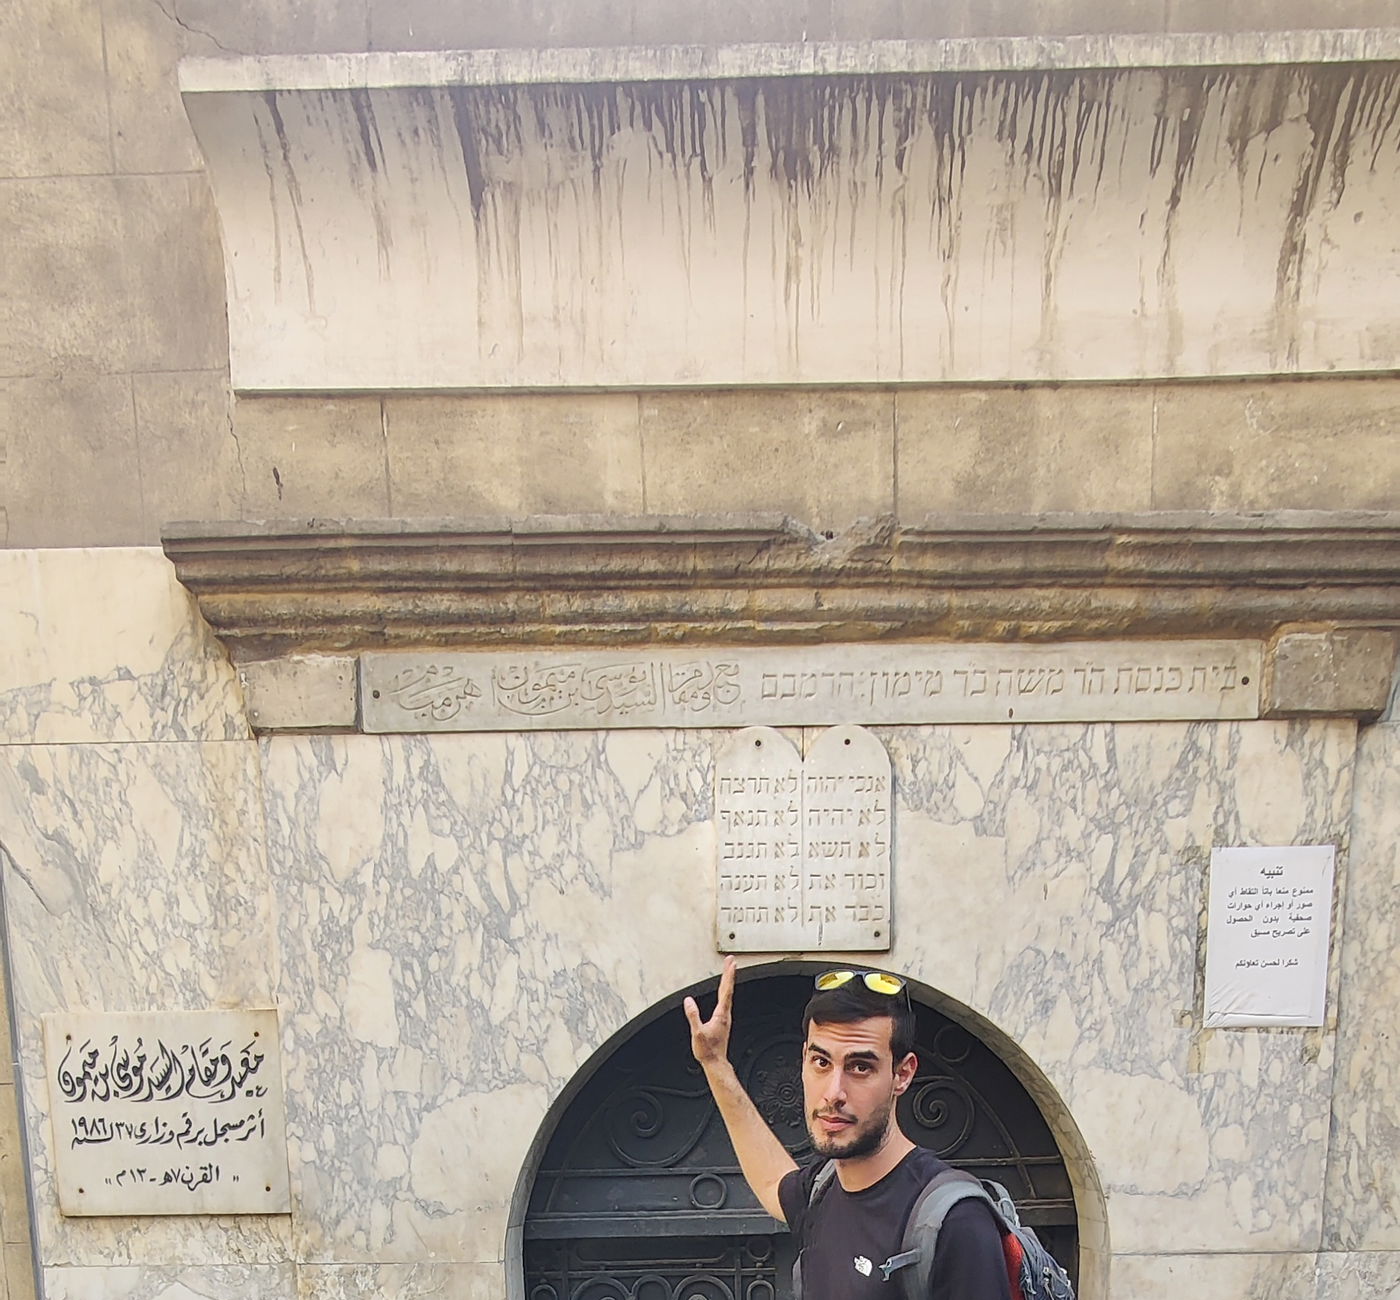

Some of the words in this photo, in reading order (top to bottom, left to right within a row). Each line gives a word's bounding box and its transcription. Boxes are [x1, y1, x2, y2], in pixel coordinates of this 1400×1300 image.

[995, 667, 1064, 697] משה
[1113, 665, 1183, 695] כנסת
[1187, 664, 1237, 694] בית
[719, 777, 770, 795] תרצח
[773, 768, 798, 794] לא
[806, 776, 844, 793] יהוה
[848, 775, 886, 793] אנכי
[720, 809, 768, 834] תנאף
[773, 800, 799, 827] לא
[808, 808, 853, 827] יהיה
[857, 799, 886, 826] לא
[773, 833, 800, 859] לא
[808, 841, 851, 858] תשא
[857, 832, 886, 858] לא
[773, 865, 800, 891] לא
[844, 873, 886, 890] זכור
[1260, 866, 1284, 879] تنبيه
[720, 874, 768, 893] תענה
[808, 873, 836, 891] את
[1291, 886, 1314, 898] ممنوع
[720, 906, 769, 923] תחמד
[773, 896, 798, 923] לא
[844, 905, 886, 922] כבד
[1296, 901, 1313, 911] صور
[1225, 914, 1254, 925] الحصول
[1262, 915, 1280, 924] بدون
[1271, 927, 1296, 938] تصريح
[1296, 927, 1311, 938] على
[1260, 957, 1281, 969] لحسن
[203, 1117, 246, 1147] مسجل
[180, 1162, 220, 1192] القرن
